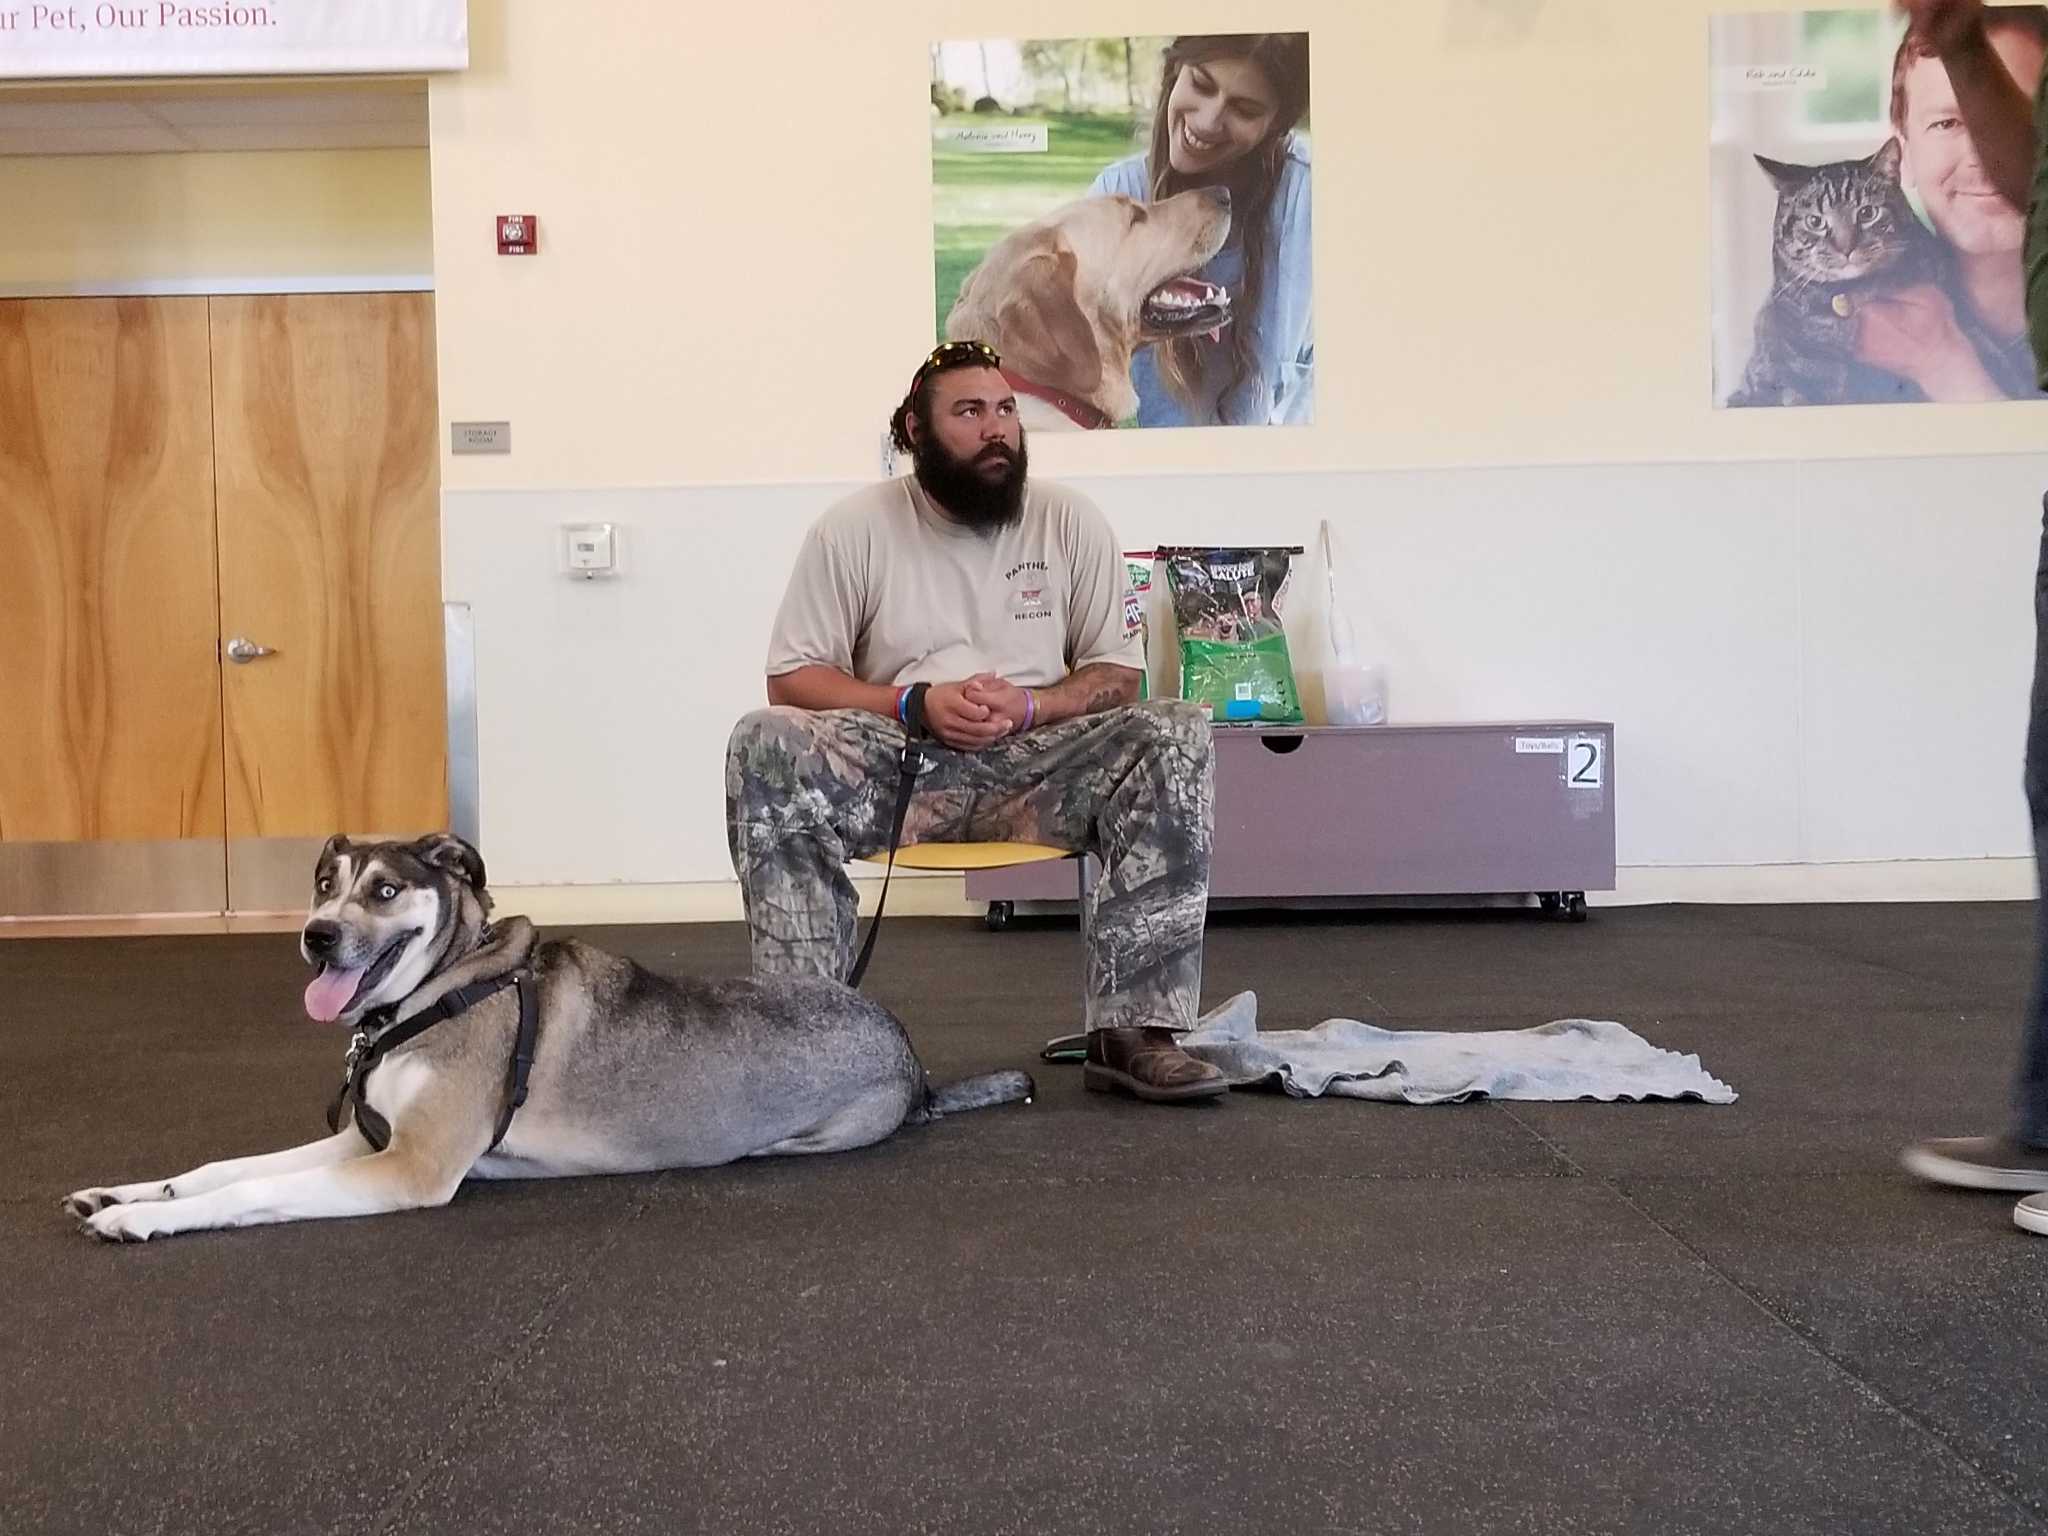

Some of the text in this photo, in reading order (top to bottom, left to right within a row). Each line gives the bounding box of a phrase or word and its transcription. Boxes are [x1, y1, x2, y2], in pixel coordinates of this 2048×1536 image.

[33, 5, 87, 32] Pet,
[96, 5, 149, 28] Our
[158, 1, 277, 27] Passion.
[508, 215, 523, 223] FIRE
[1005, 561, 1048, 580] PANTHE
[1014, 611, 1052, 620] RECON
[1572, 743, 1598, 783] 2
